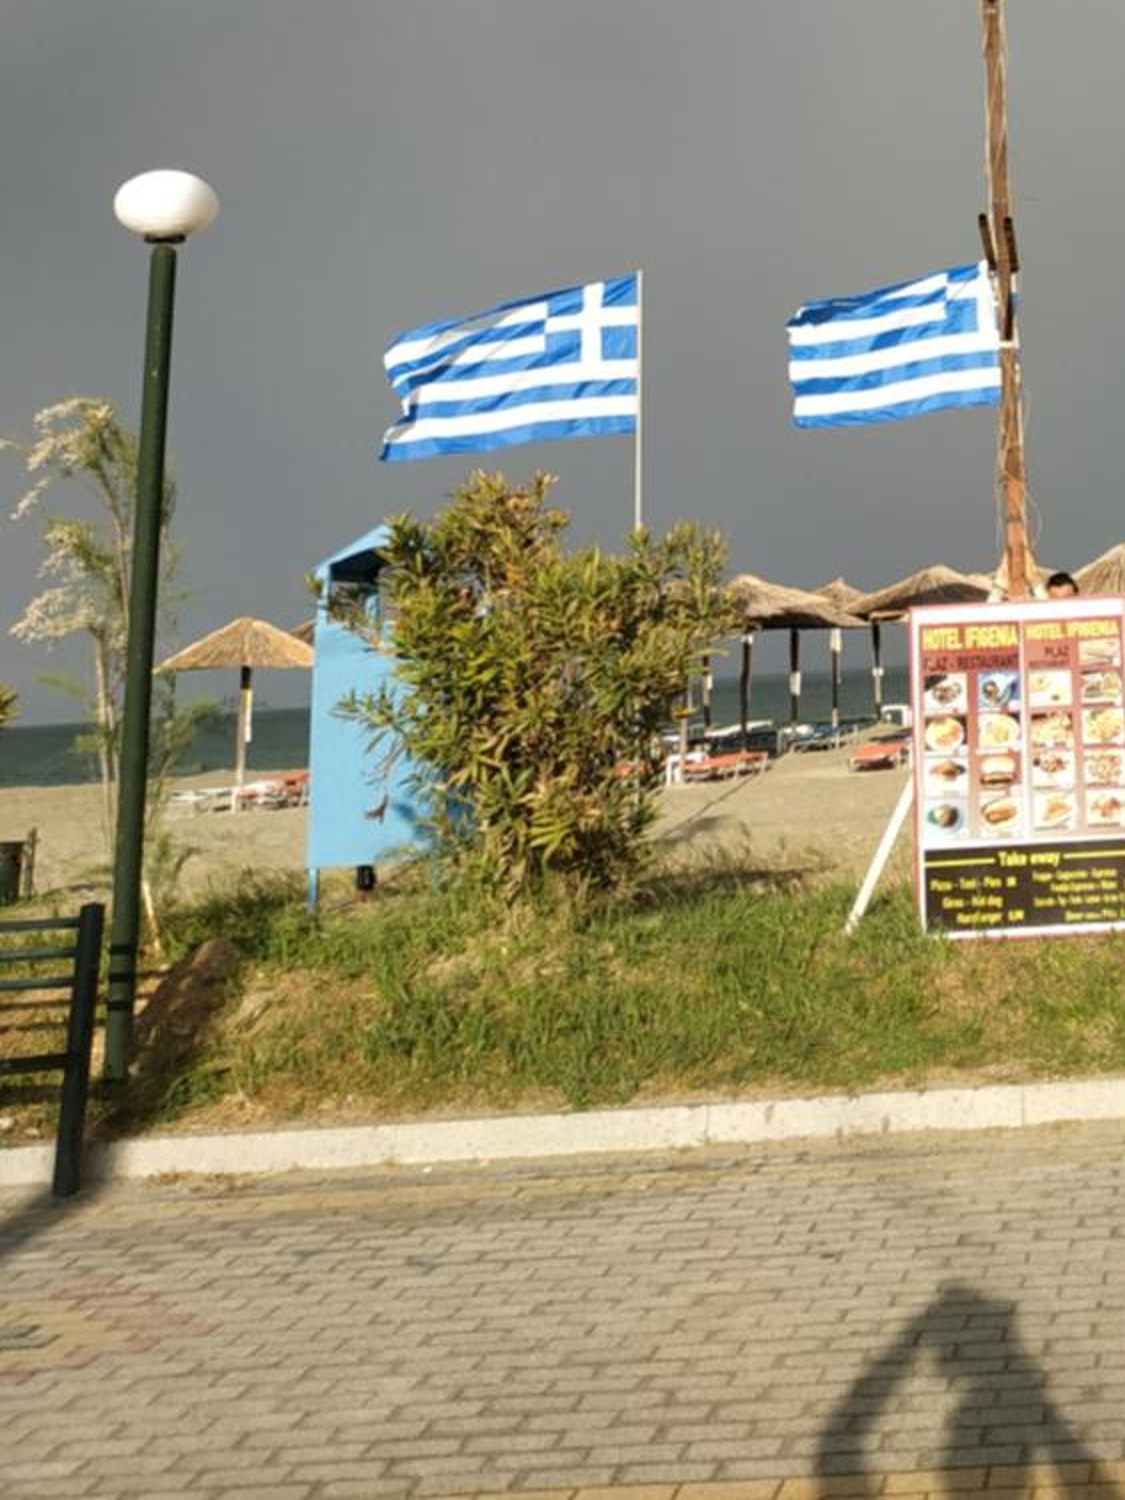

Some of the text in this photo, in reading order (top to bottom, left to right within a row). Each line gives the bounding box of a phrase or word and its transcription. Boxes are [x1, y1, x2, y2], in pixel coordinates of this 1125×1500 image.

[922, 627, 963, 651] HOTEL
[1024, 622, 1066, 641] HOTEL
[998, 851, 1027, 867] Take
